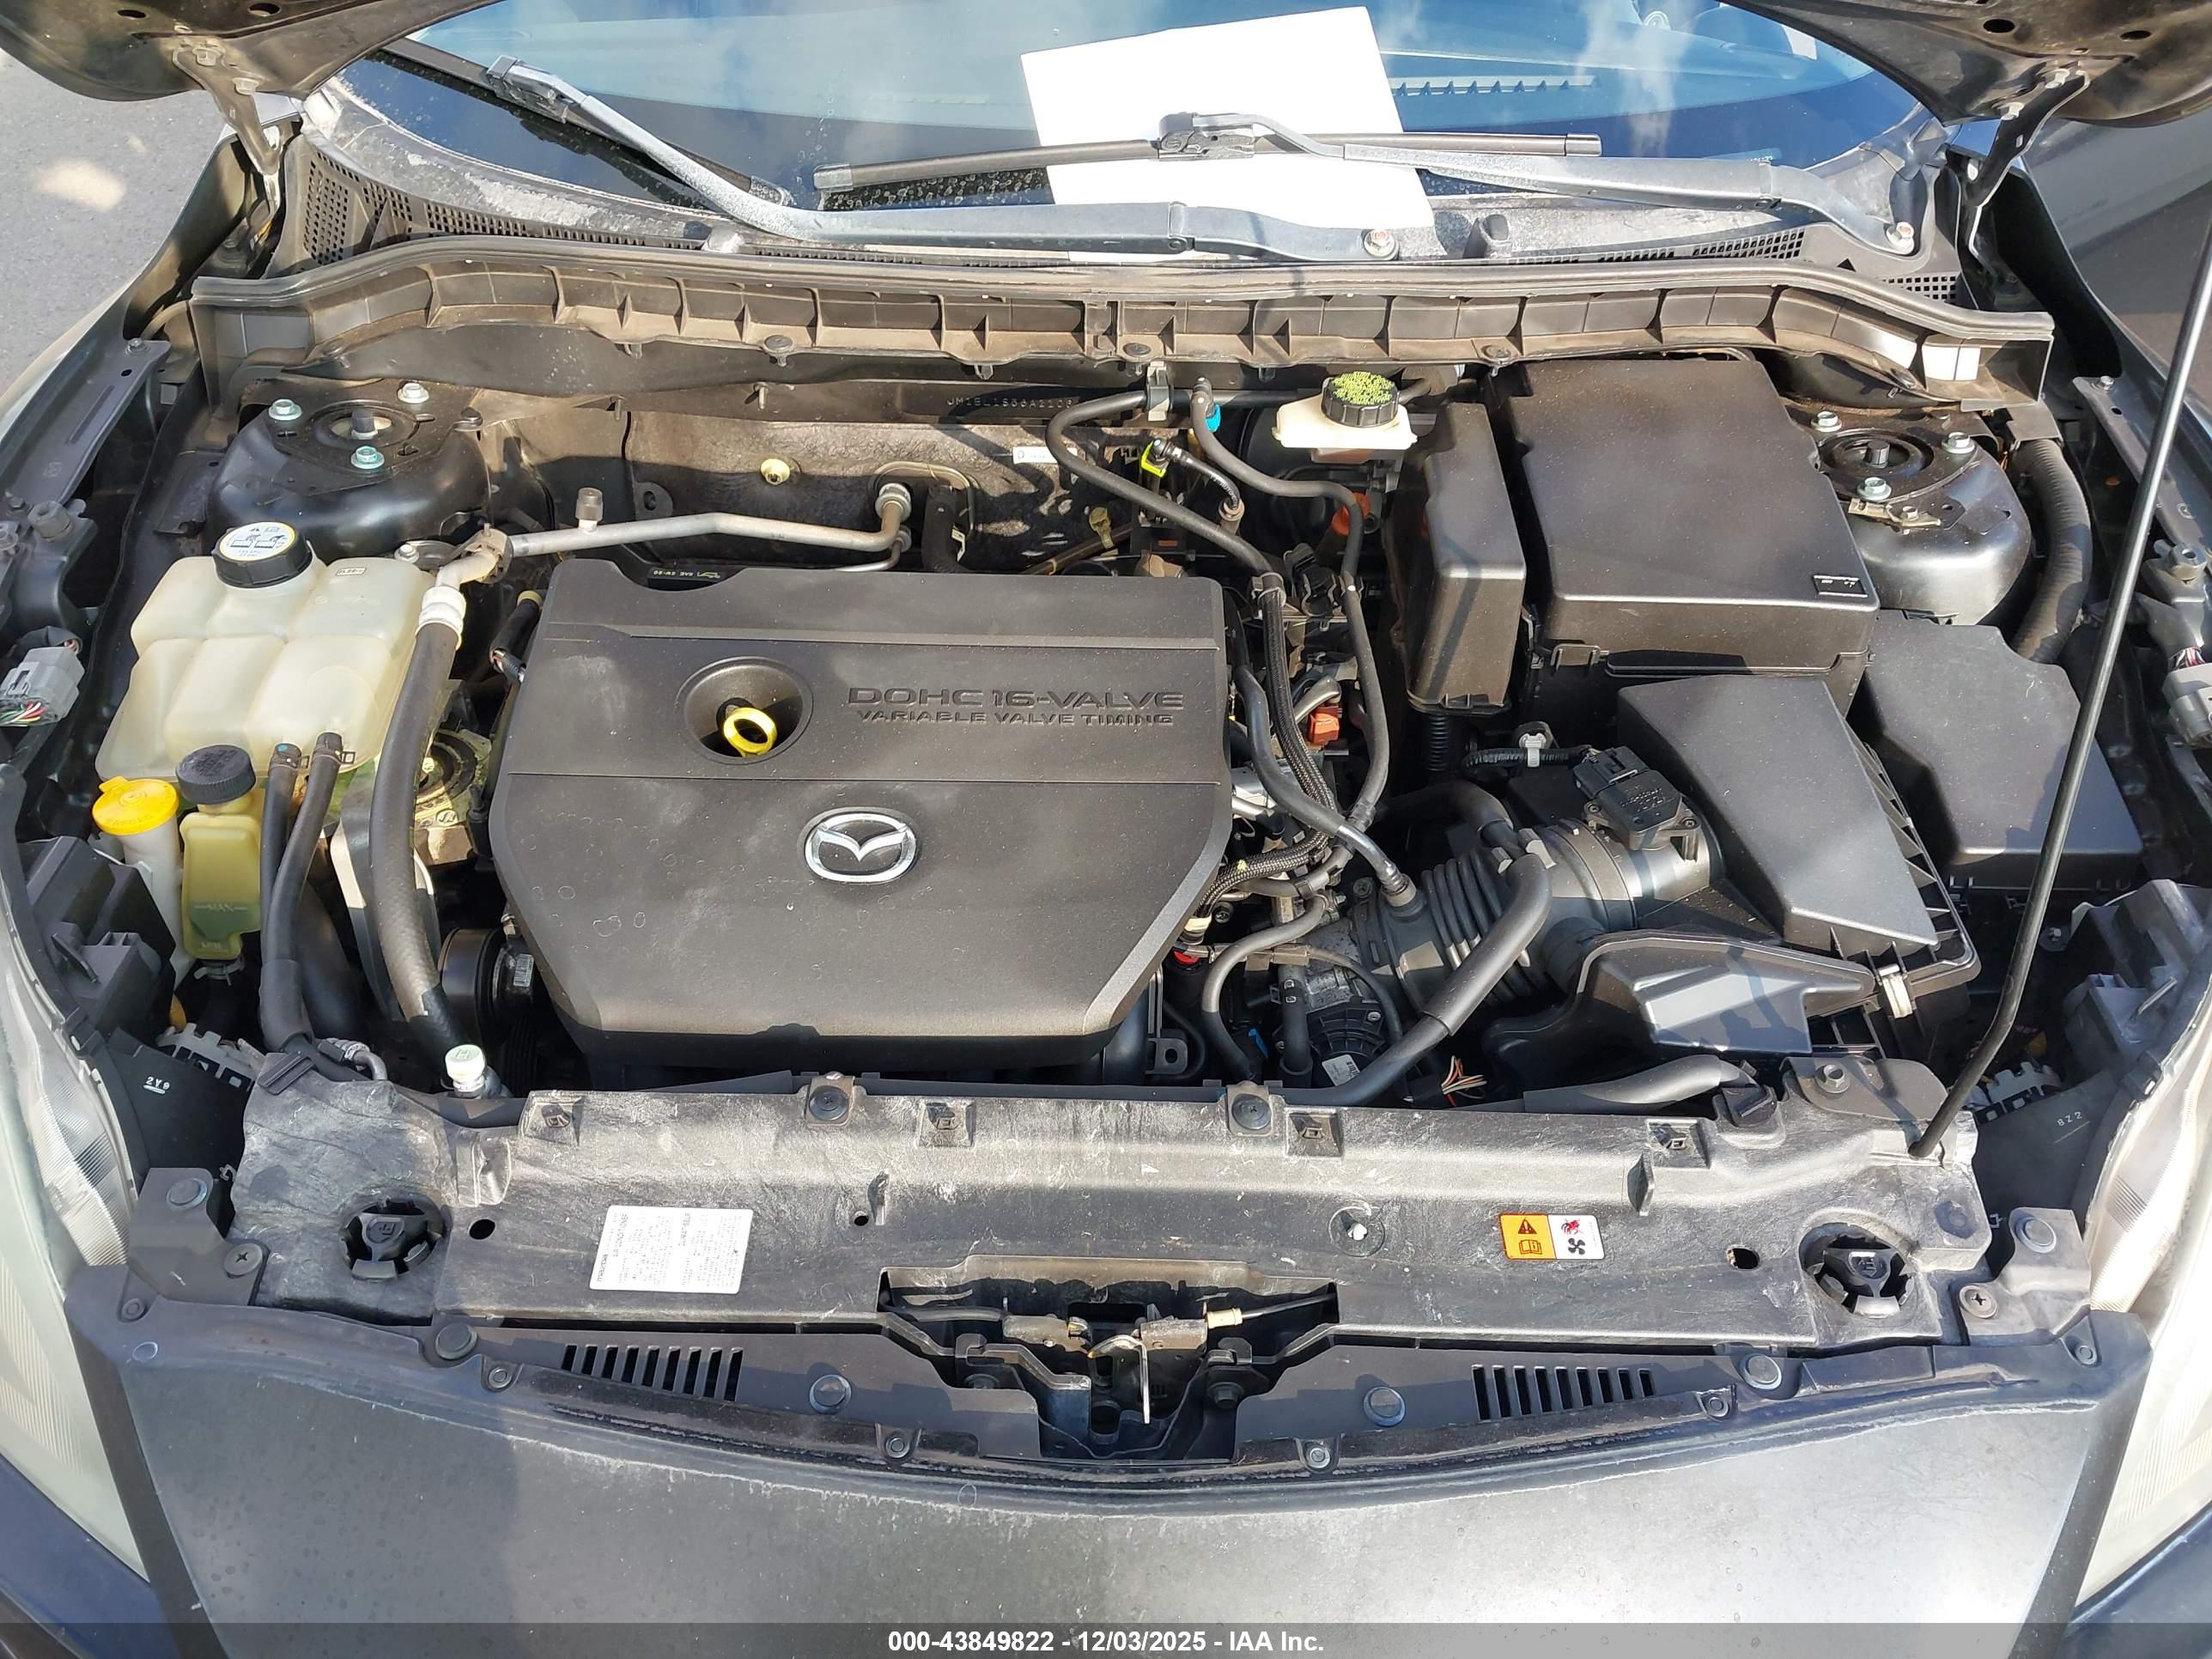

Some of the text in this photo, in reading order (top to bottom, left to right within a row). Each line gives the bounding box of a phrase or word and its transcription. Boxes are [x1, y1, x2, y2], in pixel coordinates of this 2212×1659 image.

[848, 687, 1184, 710] DOHC 16-VALVE
[857, 710, 1175, 726] VARIABLE VALVE TIMING
